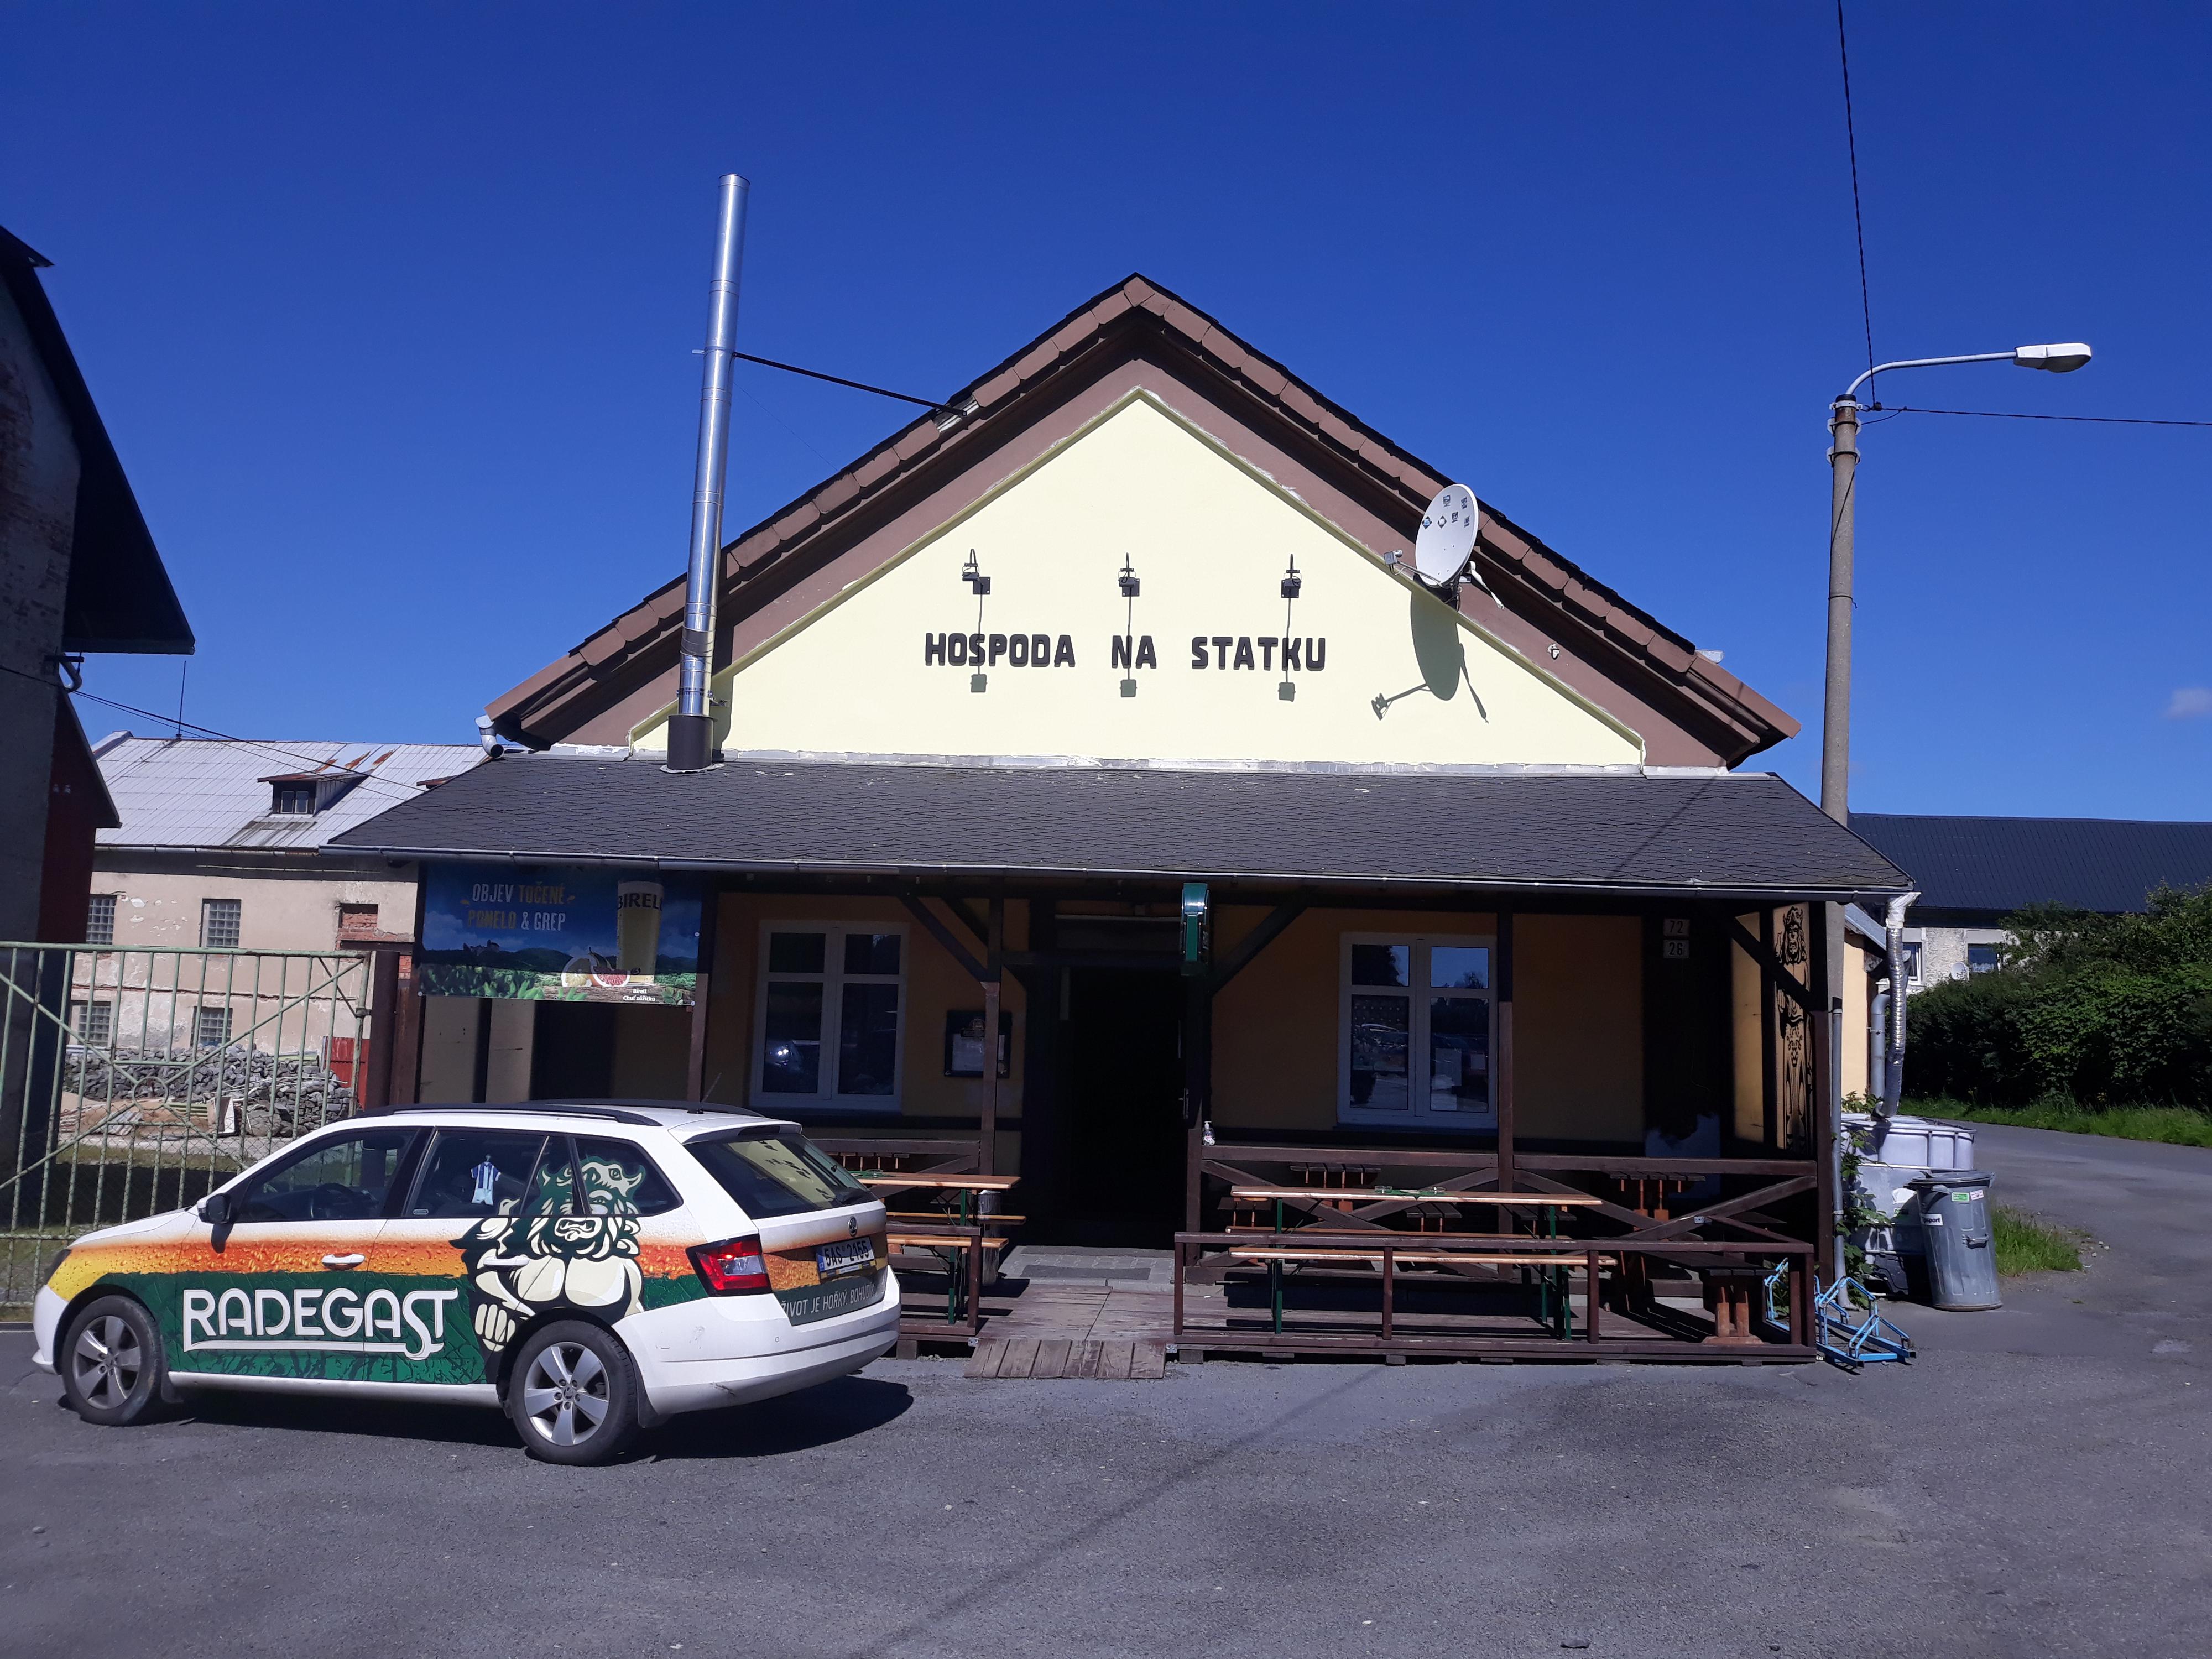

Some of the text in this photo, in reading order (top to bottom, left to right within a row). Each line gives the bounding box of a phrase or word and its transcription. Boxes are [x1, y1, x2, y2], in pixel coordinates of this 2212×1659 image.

[925, 633, 1326, 671] HOSPODA NA STATKU
[472, 881, 566, 905] OBJEV TOČENÉ
[468, 910, 567, 931] POMELO & GREP
[1670, 920, 1684, 934] 72
[1669, 942, 1683, 956] 26
[825, 1240, 869, 1267] 5AS 2155
[811, 1297, 820, 1314] JE
[822, 1288, 848, 1311] HOŘKÝ.
[183, 1287, 458, 1360] RADEGAST
